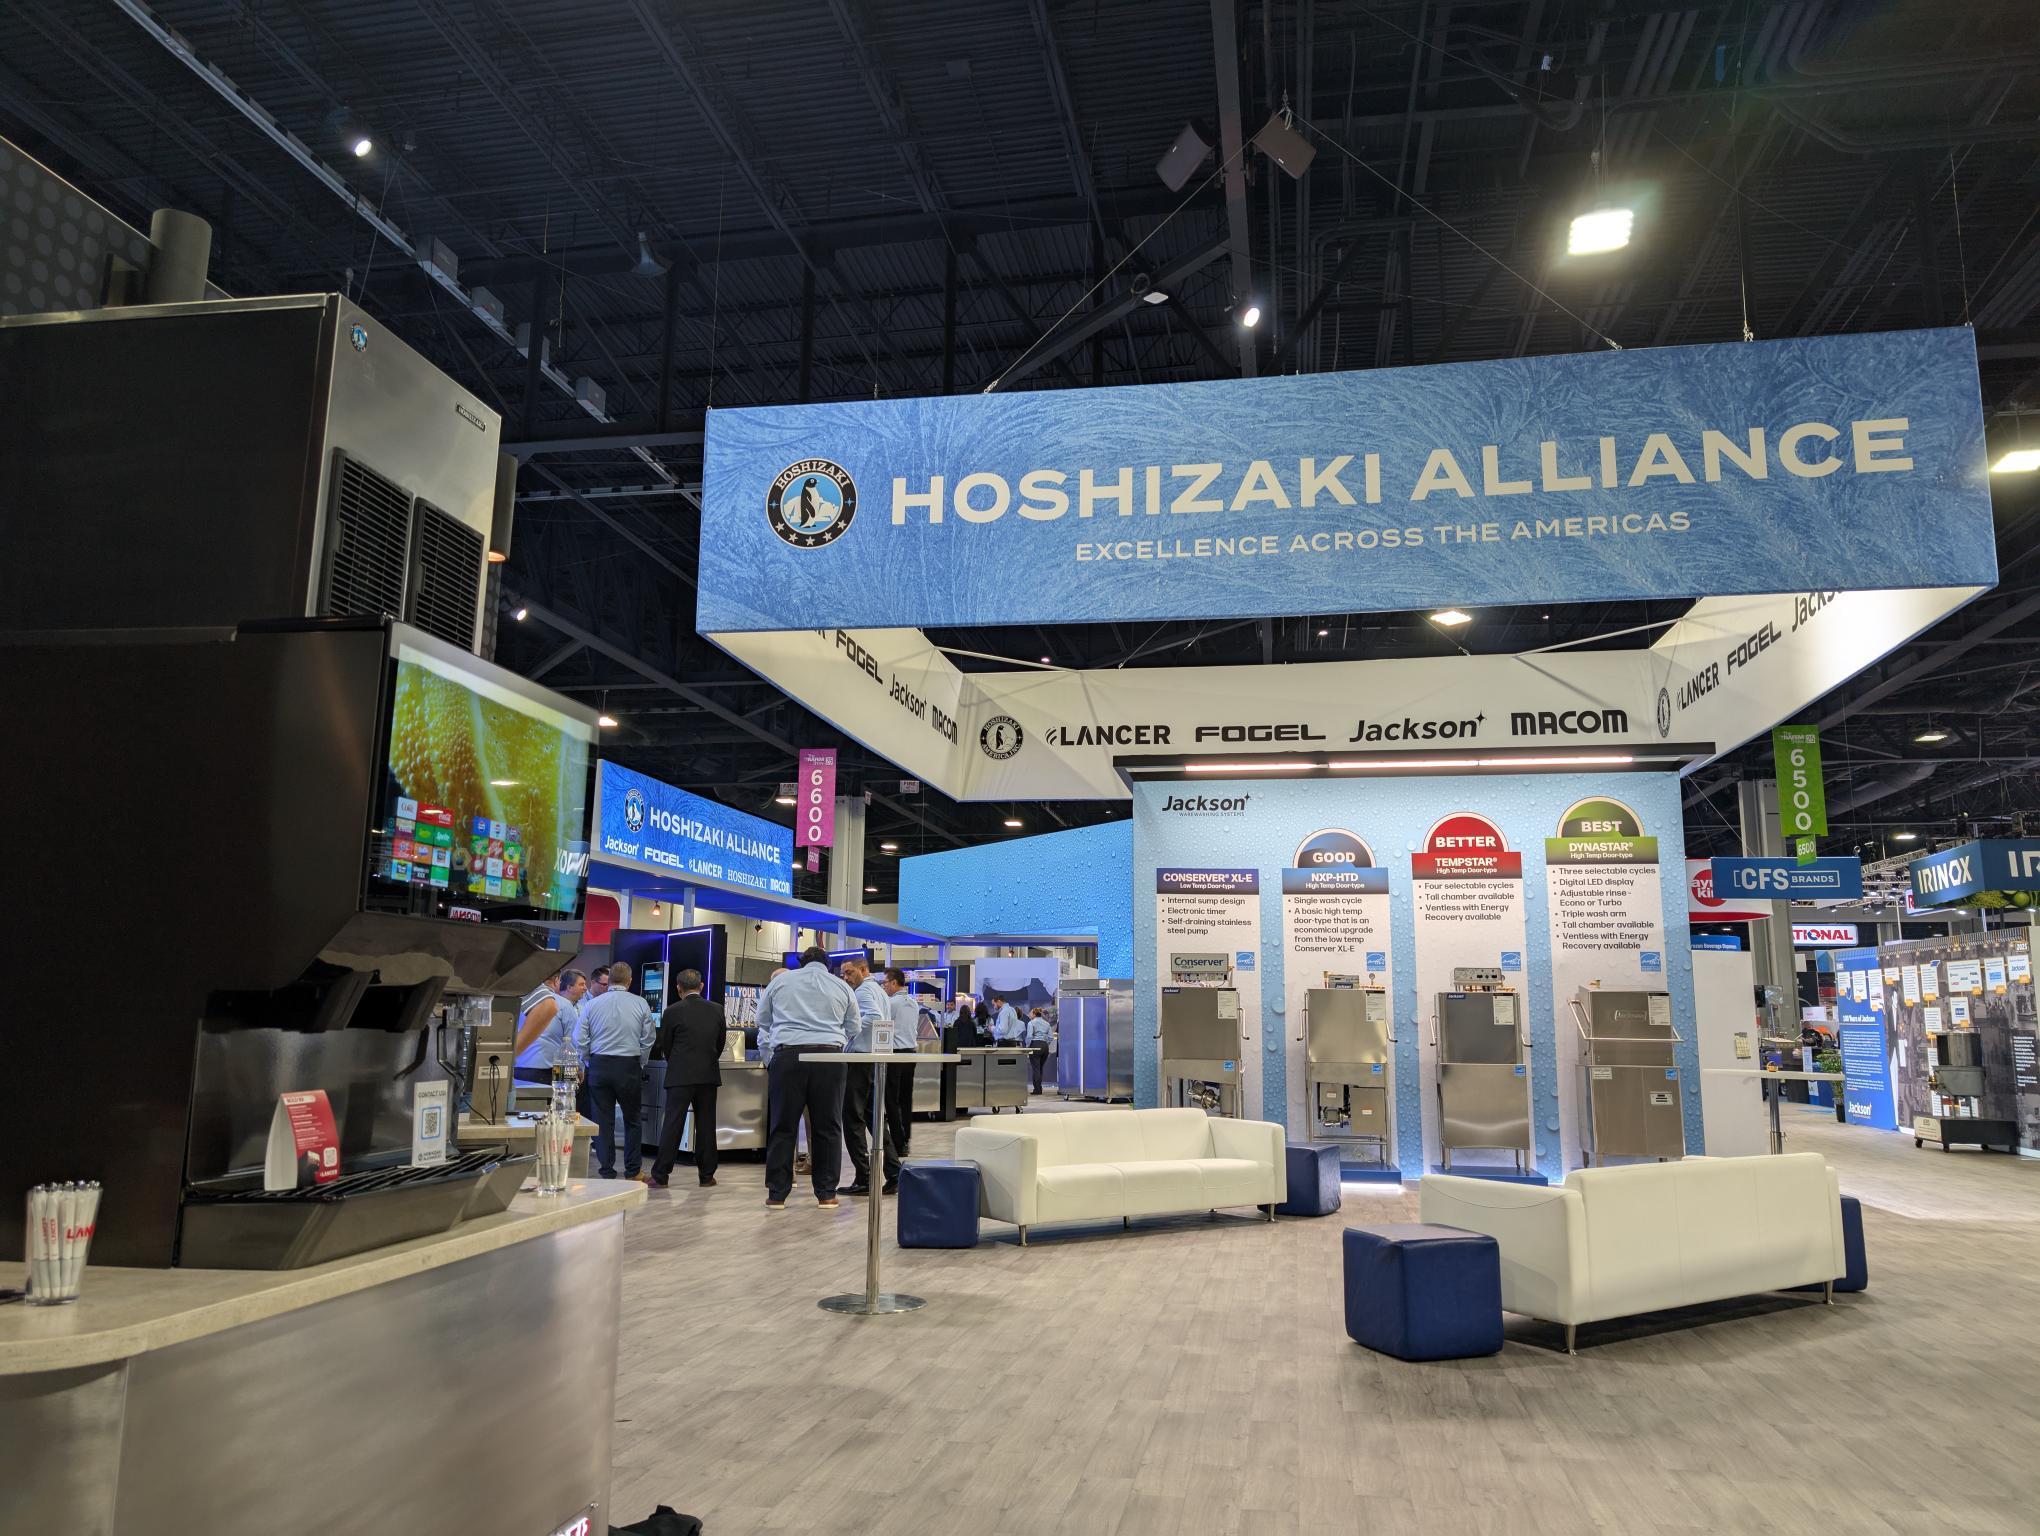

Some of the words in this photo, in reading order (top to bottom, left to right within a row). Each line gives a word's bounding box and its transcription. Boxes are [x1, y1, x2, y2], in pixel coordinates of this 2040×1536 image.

[775, 461, 850, 490] HOSHIZAKI
[891, 450, 1382, 526] HOSHIZAKI
[1410, 417, 1914, 501] ALLIANCE
[1076, 535, 1279, 561] EXCELLENCE
[1288, 528, 1424, 553] ACROSS
[1434, 523, 1500, 543] THE
[1510, 511, 1691, 540] AMERICAS
[1681, 661, 1720, 710] LANCER
[1727, 620, 1781, 675] FOGEL
[836, 629, 883, 685] FOGEL
[889, 673, 926, 720] Jackson
[932, 704, 958, 746] MACOM
[1061, 724, 1171, 746] LANCER
[1195, 724, 1327, 743] FOGEL
[1349, 716, 1478, 743] Jackson
[1511, 709, 1629, 736] MACOM
[1791, 748, 1813, 832] 6500
[808, 769, 823, 842] 6600
[1162, 795, 1246, 811] Jackson
[1581, 821, 1622, 832] BEST
[650, 806, 724, 848] HOSHIZAKI
[727, 834, 780, 864] ALLIANCE
[1435, 836, 1496, 847] BETTER
[1799, 841, 1815, 856] 6500
[605, 835, 638, 856] Jackson
[644, 846, 684, 868] FOGEL
[693, 858, 722, 879] LANCER
[727, 869, 768, 889] HOSHIZAKI
[1312, 852, 1356, 863] GOOD
[1629, 867, 1656, 875] cycles
[1917, 856, 1972, 894] IRINOX
[1231, 874, 1253, 882] XL-E
[1311, 873, 1358, 882] NXP-HTD
[1559, 878, 1585, 887] Digital
[1605, 878, 1634, 886] display
[1741, 868, 1790, 890] CFS
[1791, 875, 1835, 883] BRANDS
[1488, 882, 1514, 890] cycles
[1560, 889, 1604, 898] Adjustable
[1294, 897, 1318, 905] Single
[1342, 897, 1362, 905] cycle
[1324, 908, 1340, 916] high
[1342, 908, 1362, 916] temp
[1481, 904, 1509, 912] Energy
[1561, 910, 1584, 918] Triple
[1167, 918, 1216, 926] Self-draining
[1294, 917, 1332, 925] door-type
[1344, 936, 1364, 944] temp
[1619, 932, 1648, 941] Energy
[1792, 929, 1853, 941] TIONAL
[1562, 942, 1601, 950] Recovery
[1174, 957, 1224, 966] Conserver
[738, 986, 757, 998] YOUR
[1848, 1101, 1871, 1116] Jackson
